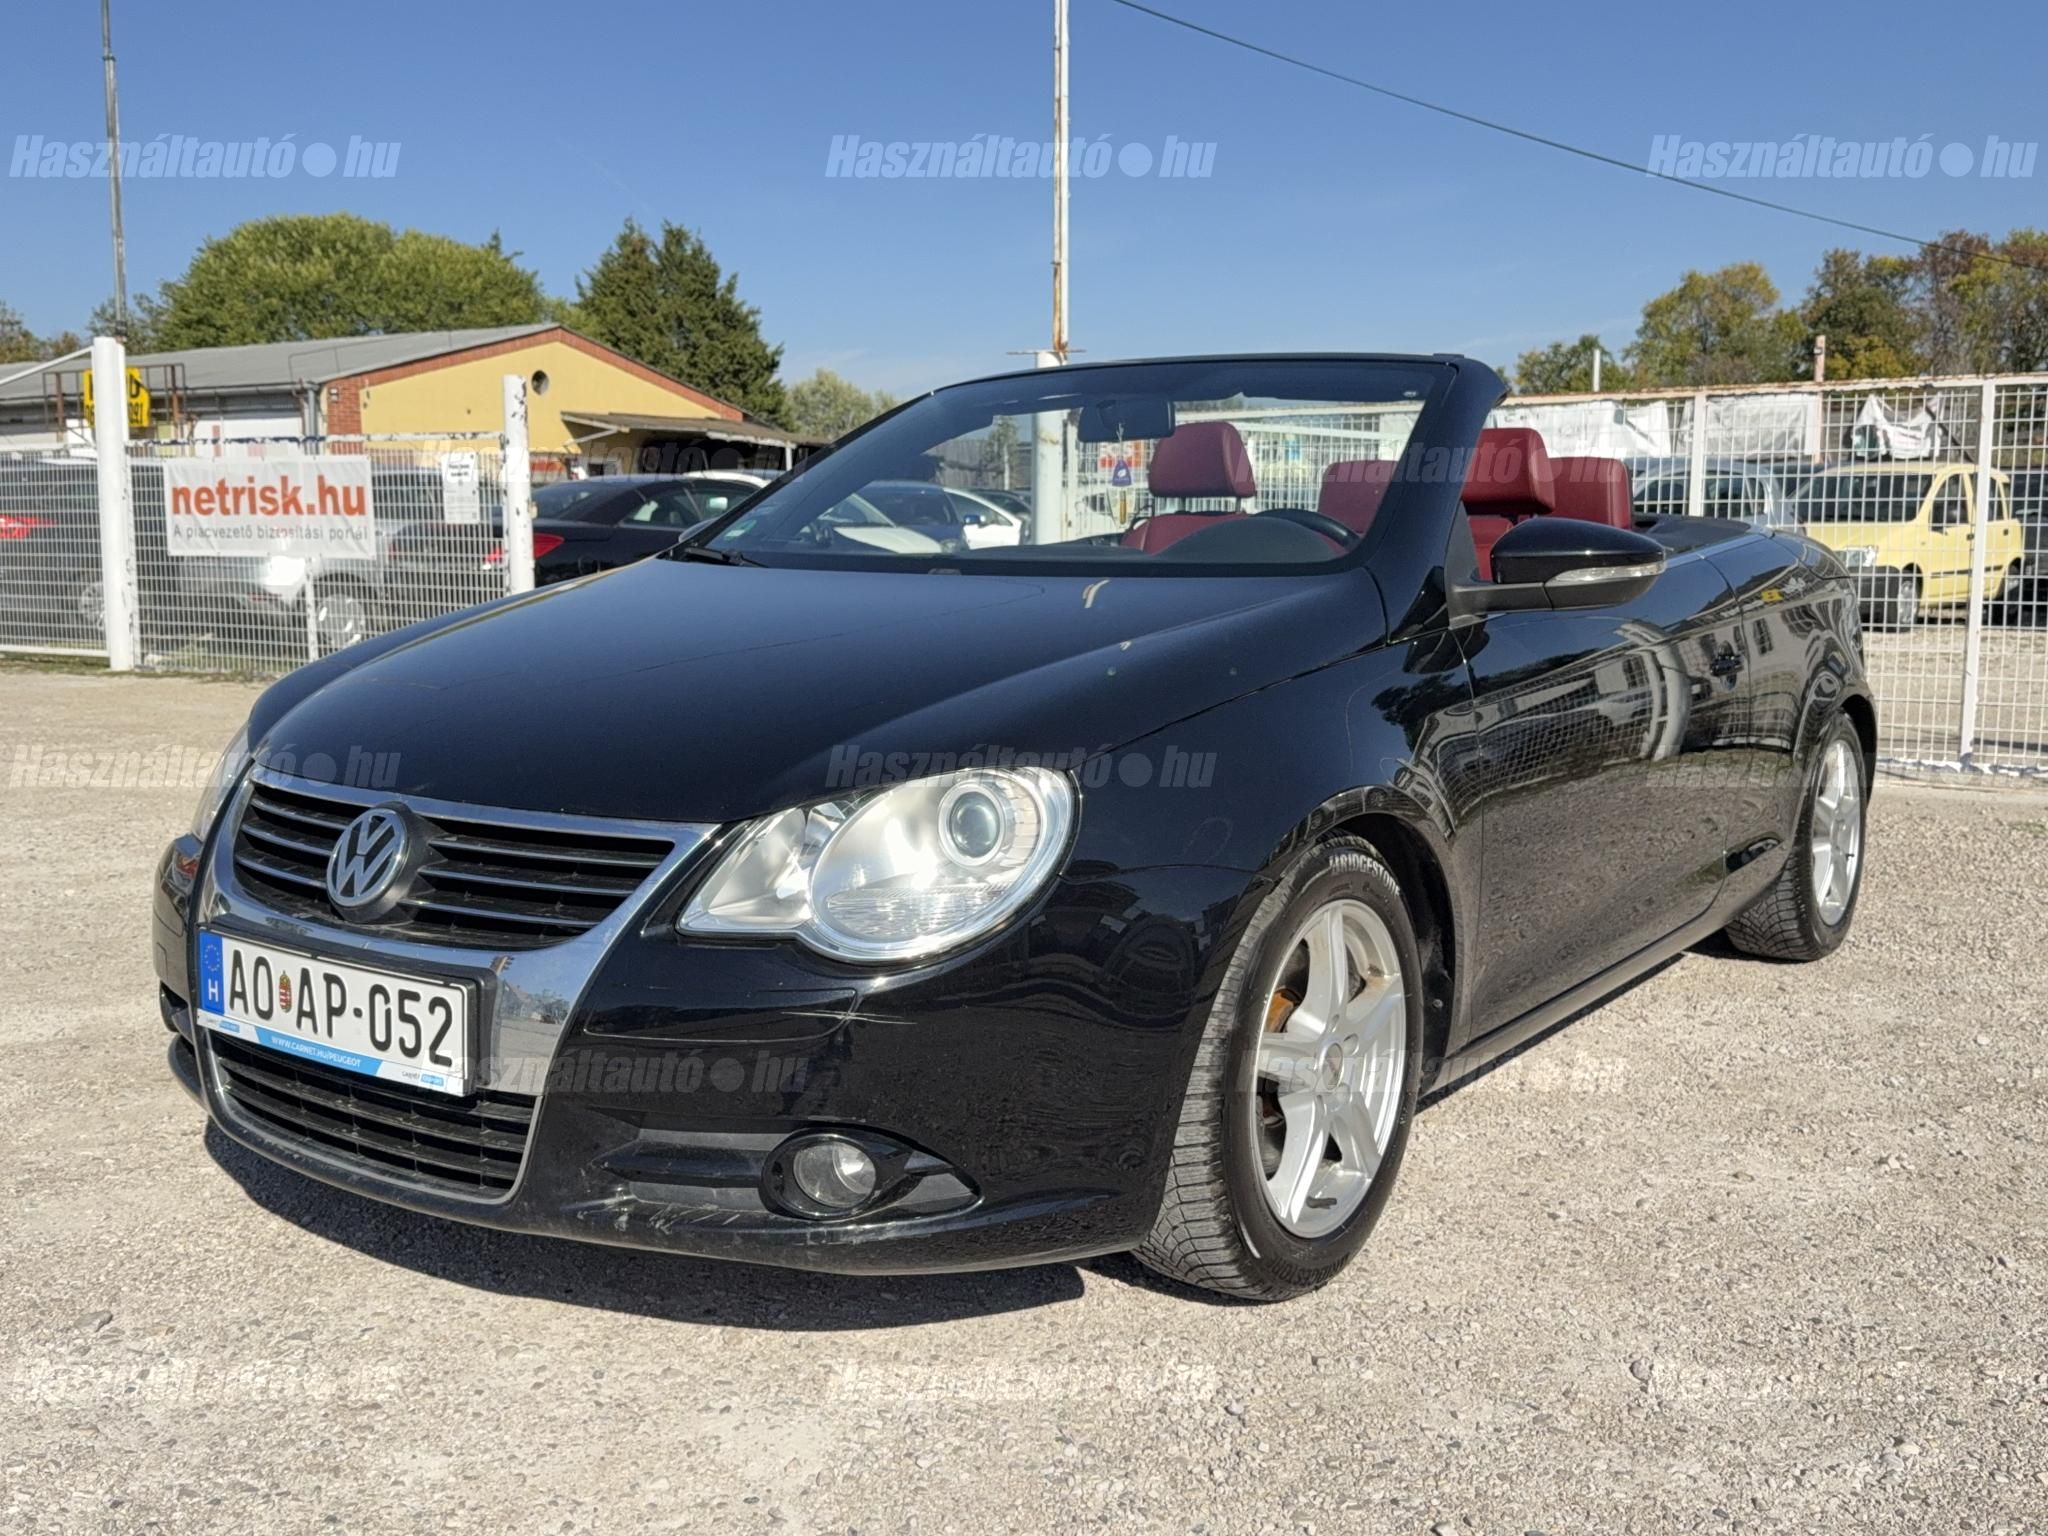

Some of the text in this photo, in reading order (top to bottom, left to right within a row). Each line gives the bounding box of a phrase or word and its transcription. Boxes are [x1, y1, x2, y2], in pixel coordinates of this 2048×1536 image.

[172, 475, 366, 516] netrisk.hu
[174, 524, 368, 540] A piacvezető biztosítási portál
[1329, 853, 1400, 896] BRIDGESTONE
[207, 979, 219, 1002] H
[229, 949, 453, 1067] AO AP-052
